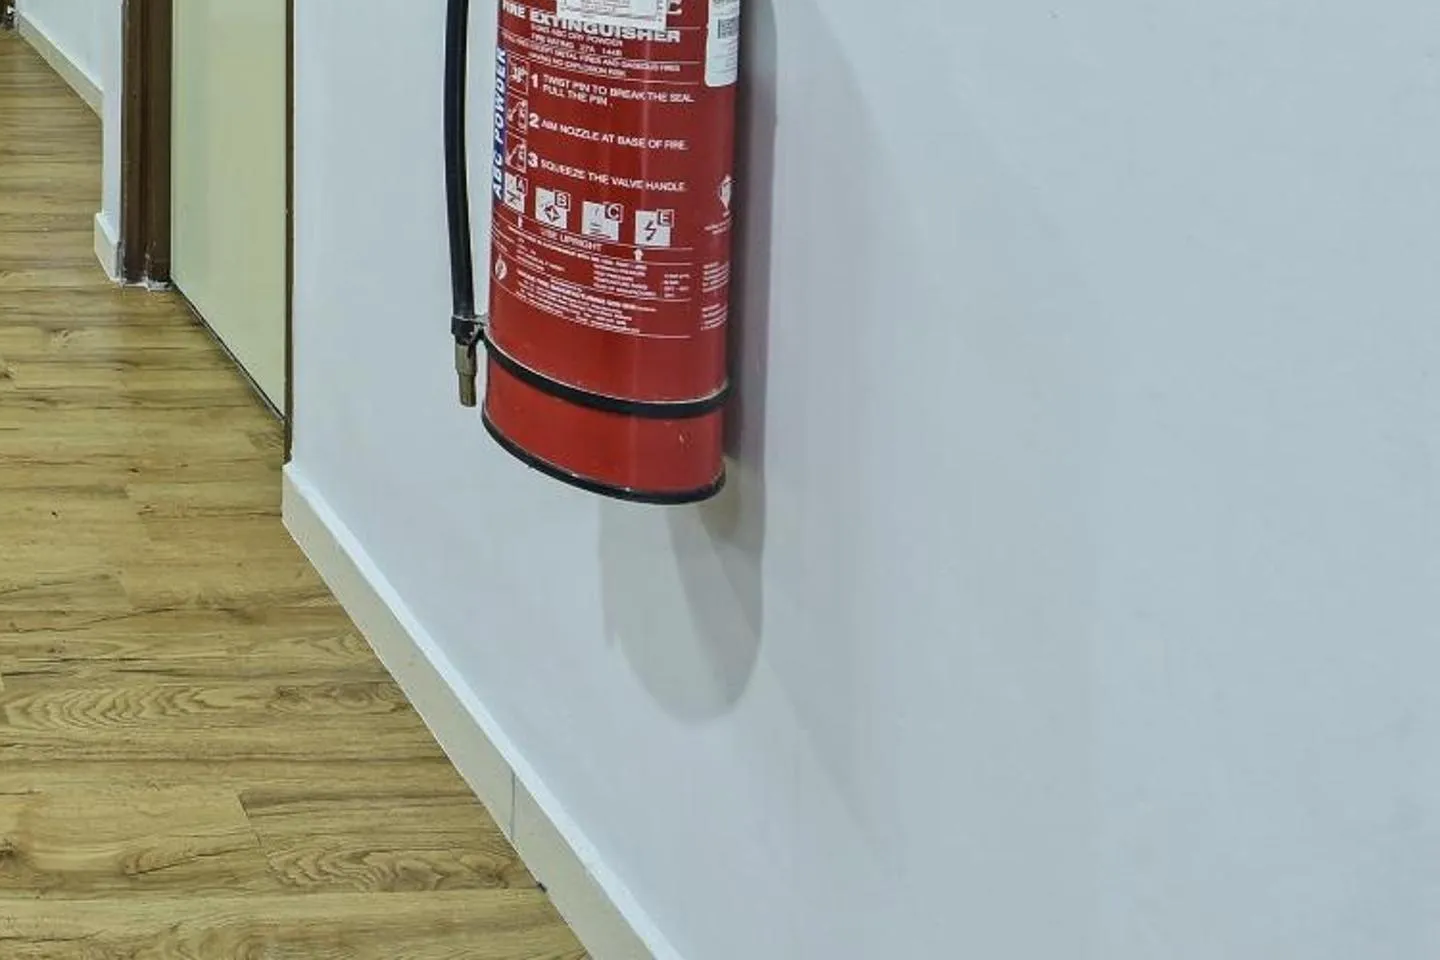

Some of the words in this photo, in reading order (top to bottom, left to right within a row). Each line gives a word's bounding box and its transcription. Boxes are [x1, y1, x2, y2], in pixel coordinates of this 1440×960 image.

[530, 8, 680, 43] EXTINGUISHER
[494, 46, 507, 144] POWDER
[531, 73, 539, 88] 1
[543, 74, 569, 89] TWIST
[571, 81, 590, 93] PIN
[591, 84, 607, 95] TO
[610, 87, 645, 101] BREAK
[646, 91, 667, 103] THE
[542, 83, 565, 98] PULL
[529, 112, 539, 129] 2
[560, 124, 599, 141] NOZZLE
[602, 133, 615, 144] AT
[617, 135, 647, 149] BASE
[648, 139, 663, 149] OF
[528, 152, 538, 169] 3
[540, 158, 586, 180] SQUEEZE
[588, 171, 609, 185] THE
[610, 176, 643, 190] VALVE
[607, 204, 620, 220] C
[660, 212, 670, 228] E
